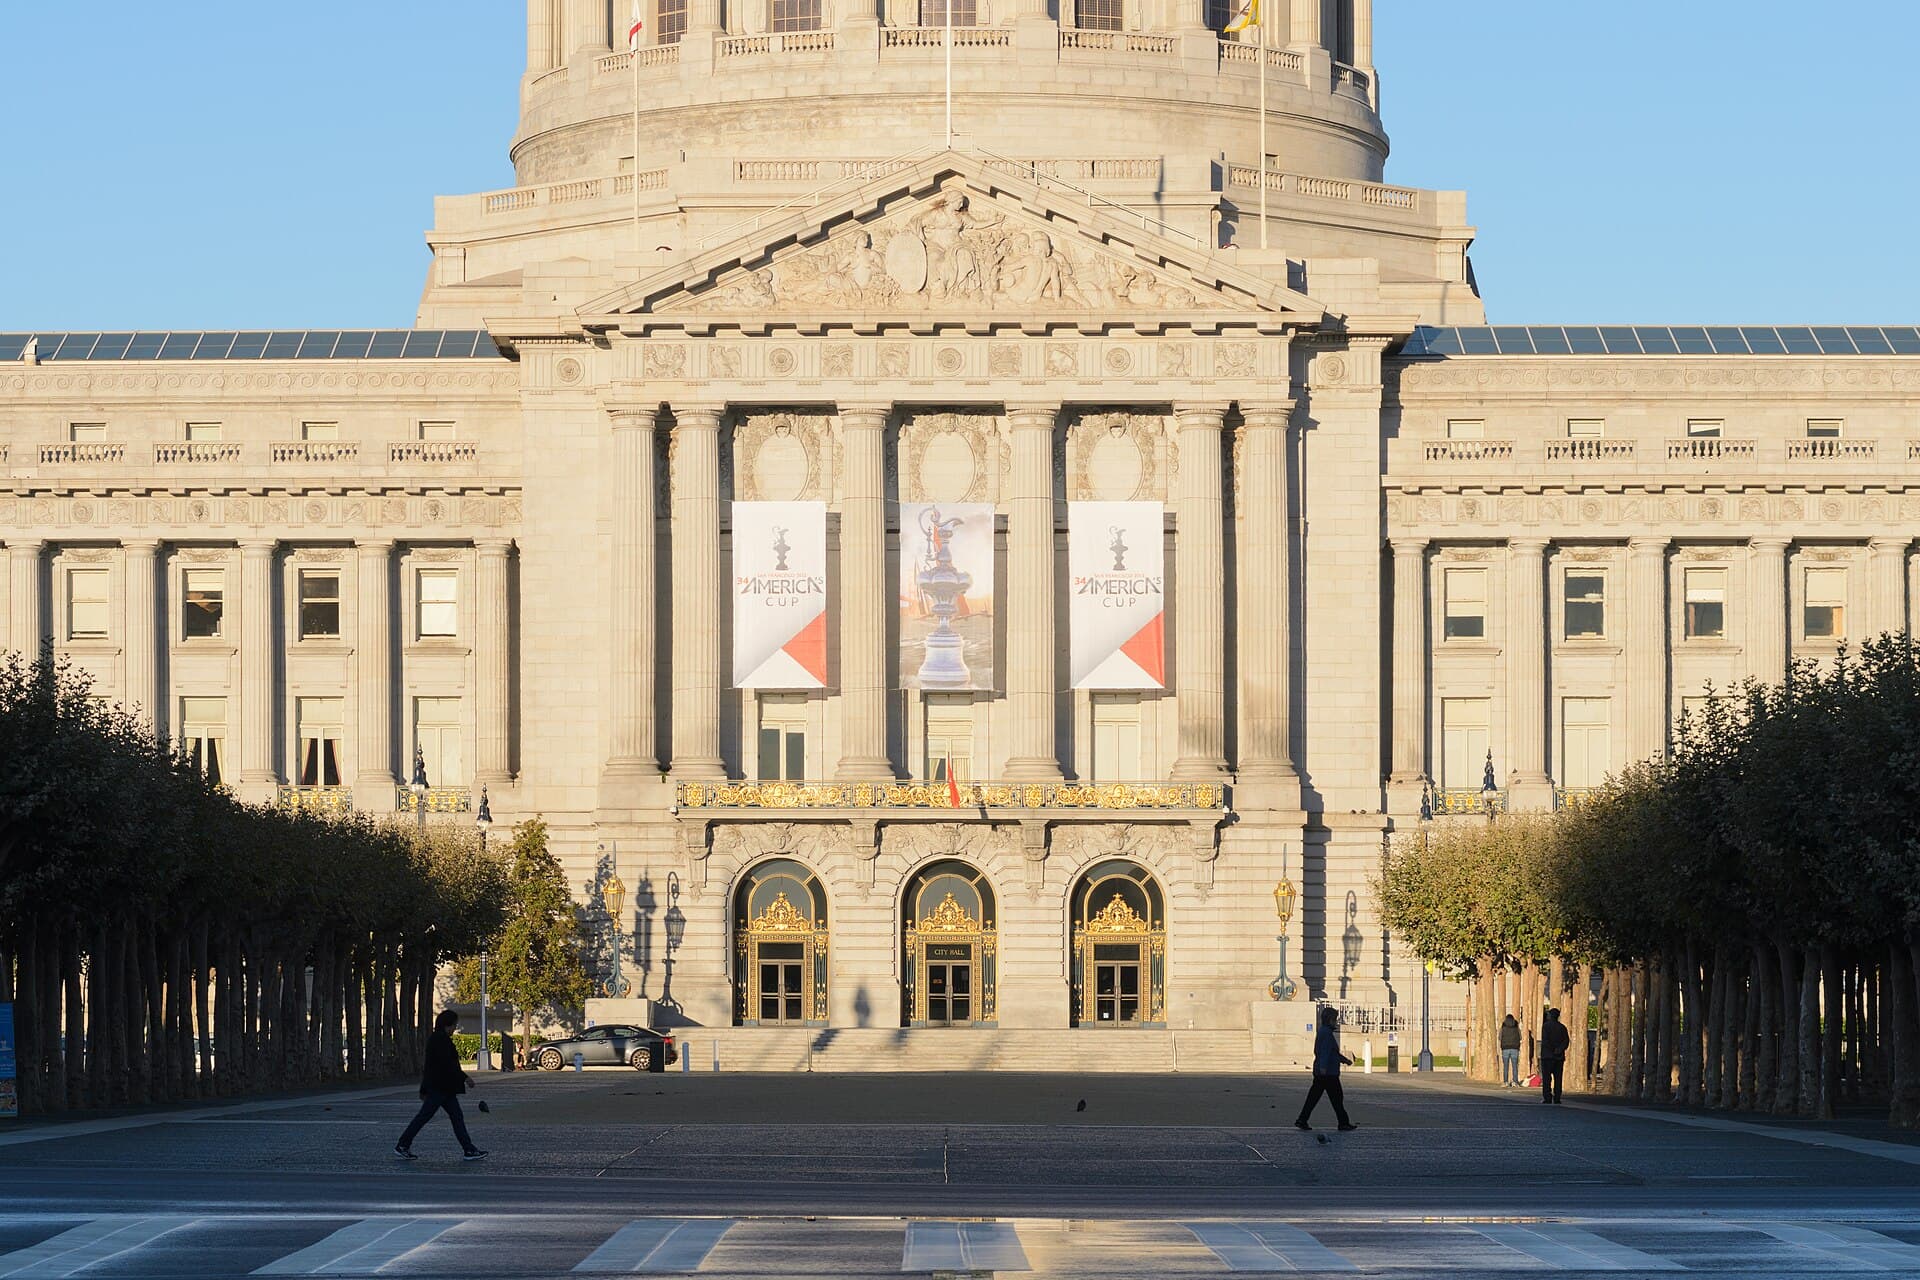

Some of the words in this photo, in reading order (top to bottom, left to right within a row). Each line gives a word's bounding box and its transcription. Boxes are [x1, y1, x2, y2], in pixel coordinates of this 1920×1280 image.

[737, 577, 749, 585] 34
[741, 576, 824, 594] AMERICA'S
[1075, 577, 1086, 585] 34
[1078, 576, 1162, 594] AMERICA'S
[765, 597, 799, 607] CUP
[1102, 597, 1136, 608] CUP
